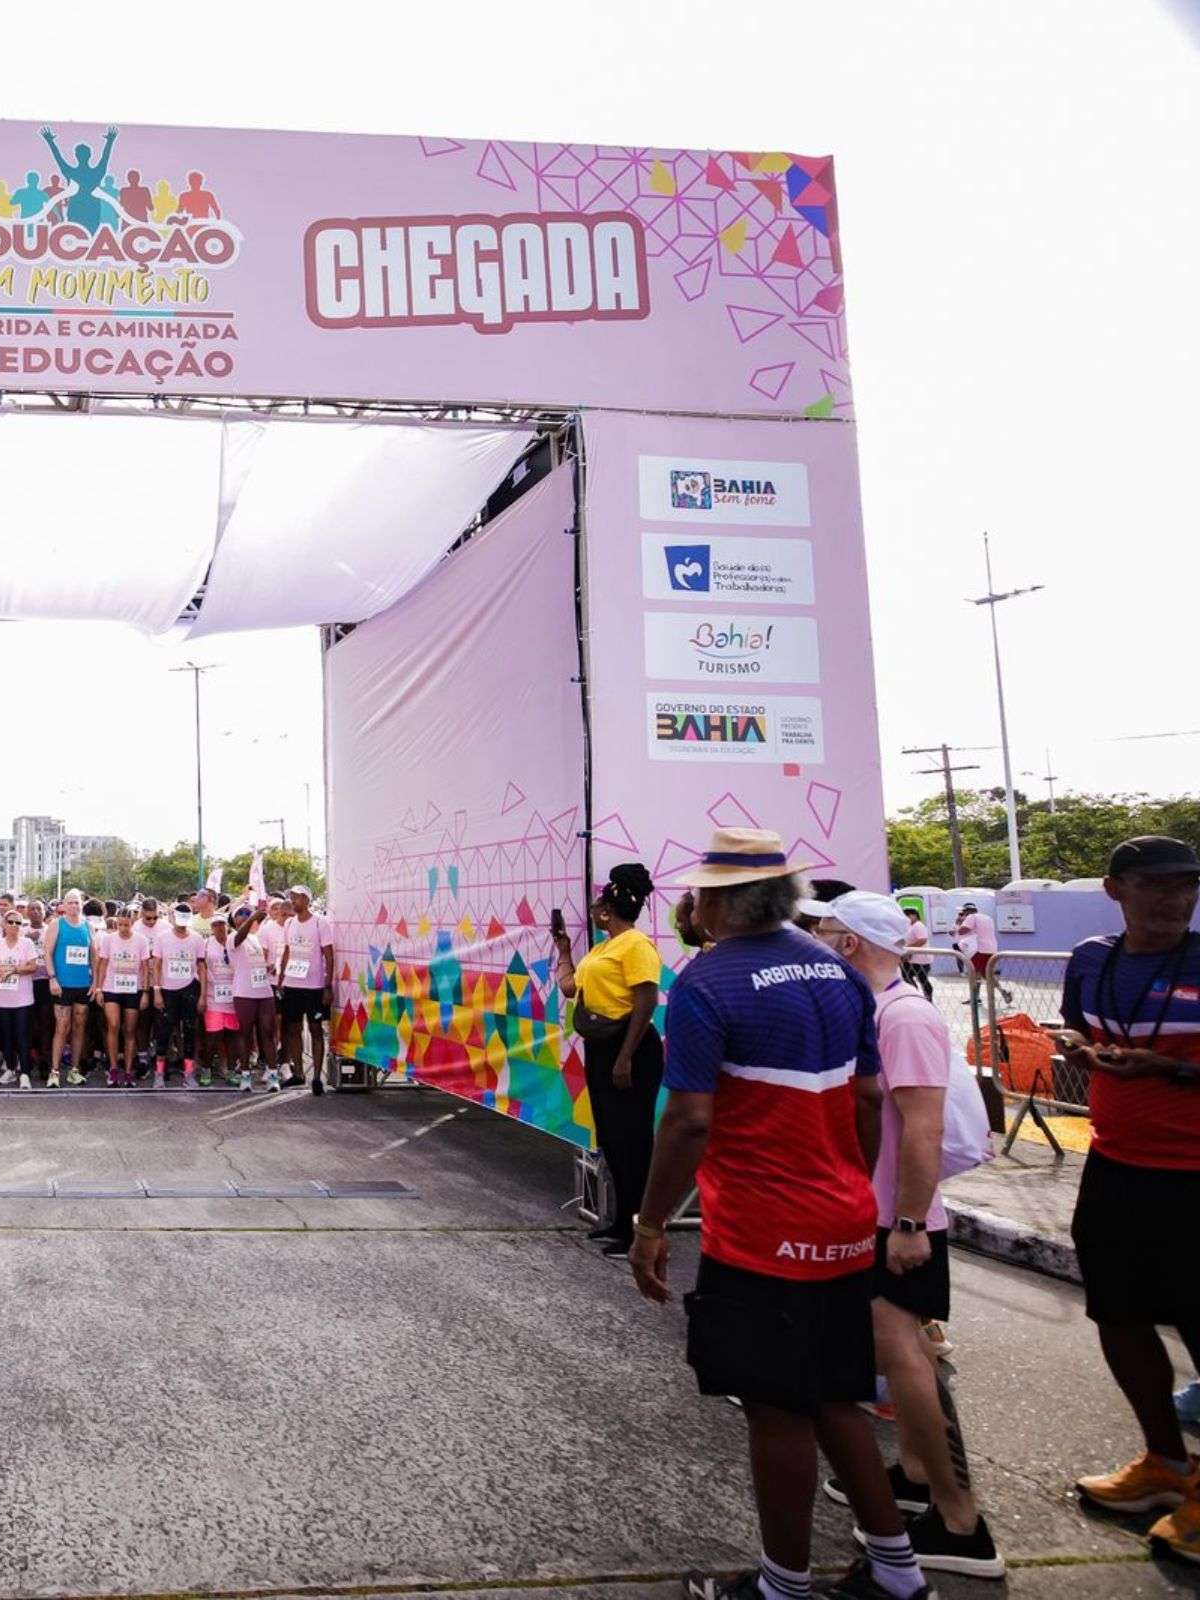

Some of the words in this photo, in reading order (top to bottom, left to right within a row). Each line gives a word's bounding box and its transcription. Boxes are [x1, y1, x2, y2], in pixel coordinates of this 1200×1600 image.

[27, 266, 210, 304] MOVIMENTO
[314, 221, 640, 325] CHEGADA
[58, 320, 71, 336] E
[78, 321, 238, 340] CAMINHADA
[713, 479, 776, 494] BAHIA
[689, 622, 774, 650] Bahia!
[697, 660, 761, 674] TURISMO
[655, 703, 706, 713] GOVERNO
[709, 704, 724, 714] DO
[726, 704, 766, 715] ESTADO
[656, 713, 767, 743] BAHIA
[751, 963, 847, 991] ARBITRAGEM
